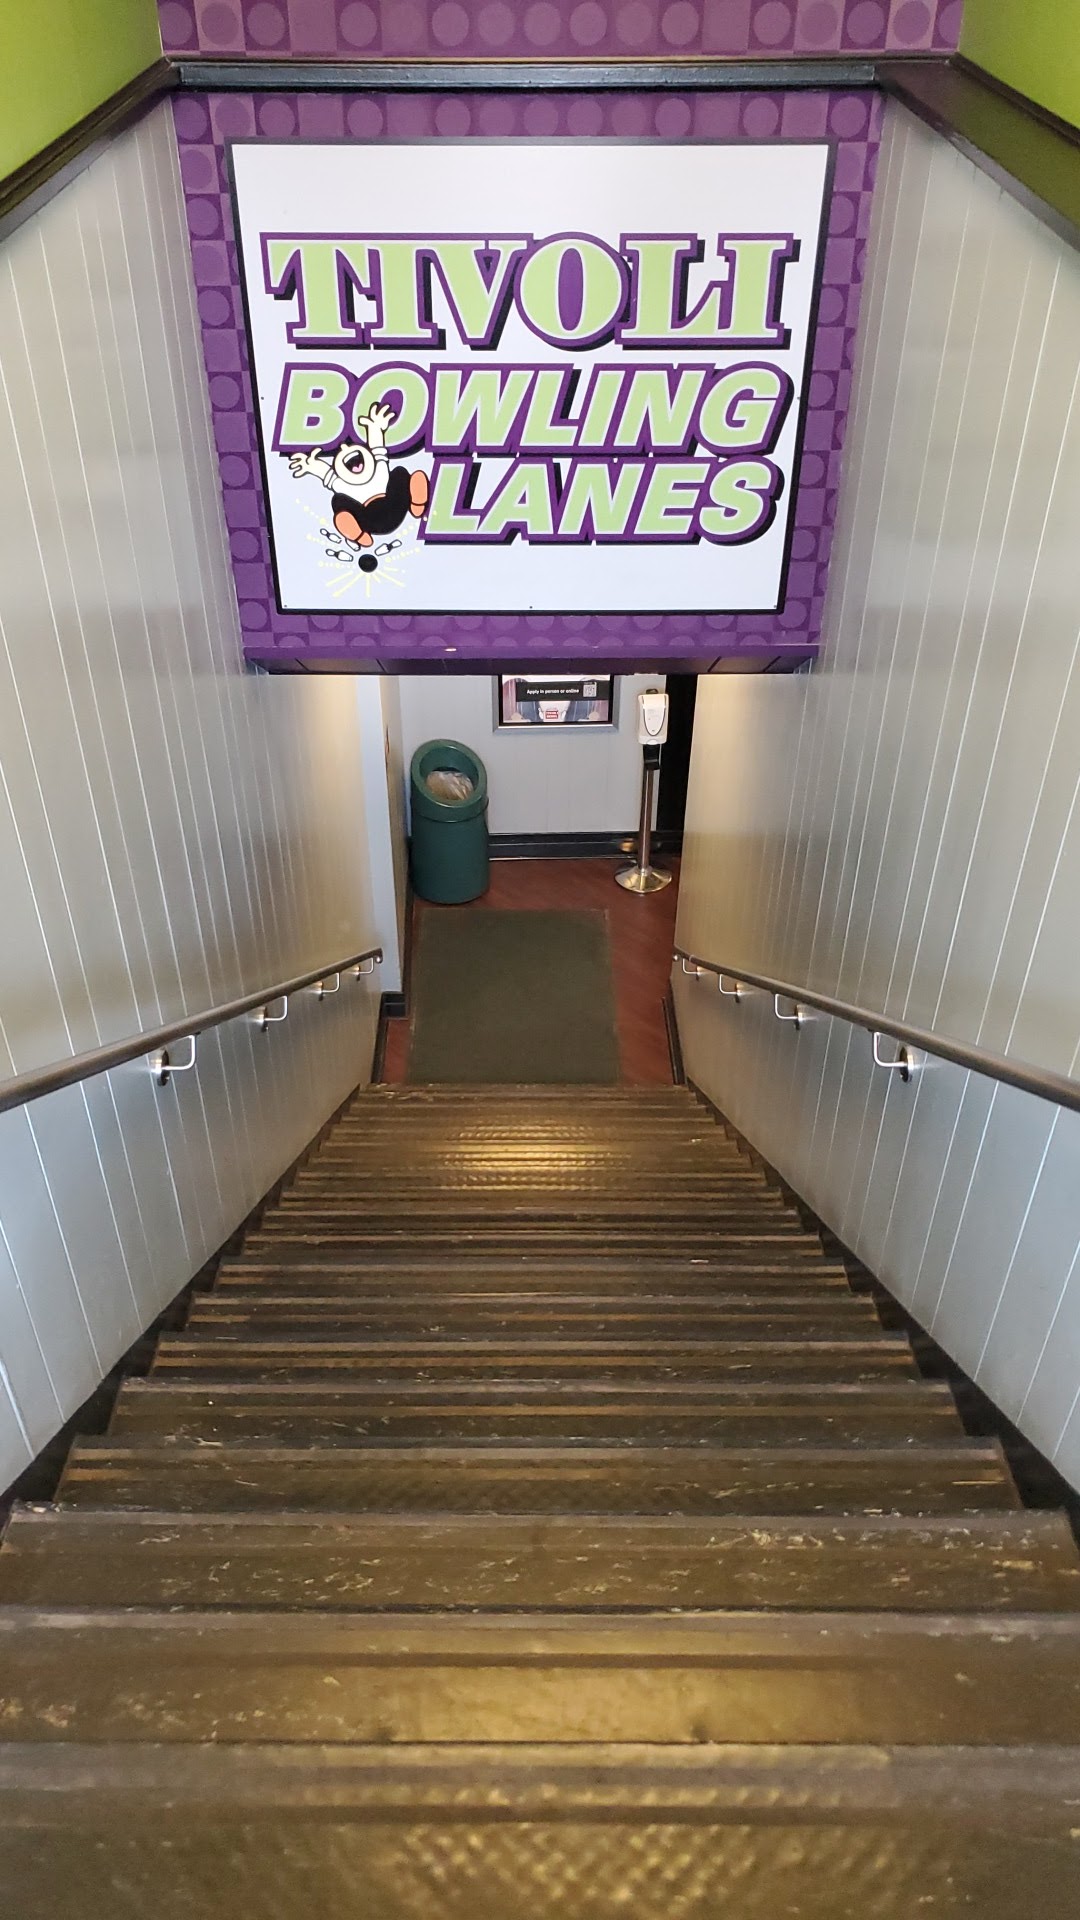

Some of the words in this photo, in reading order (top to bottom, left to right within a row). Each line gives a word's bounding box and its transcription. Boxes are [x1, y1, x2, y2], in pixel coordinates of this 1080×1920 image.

[259, 232, 800, 350] TIVOLI
[272, 361, 795, 457] BOWLING
[417, 455, 784, 545] LANES
